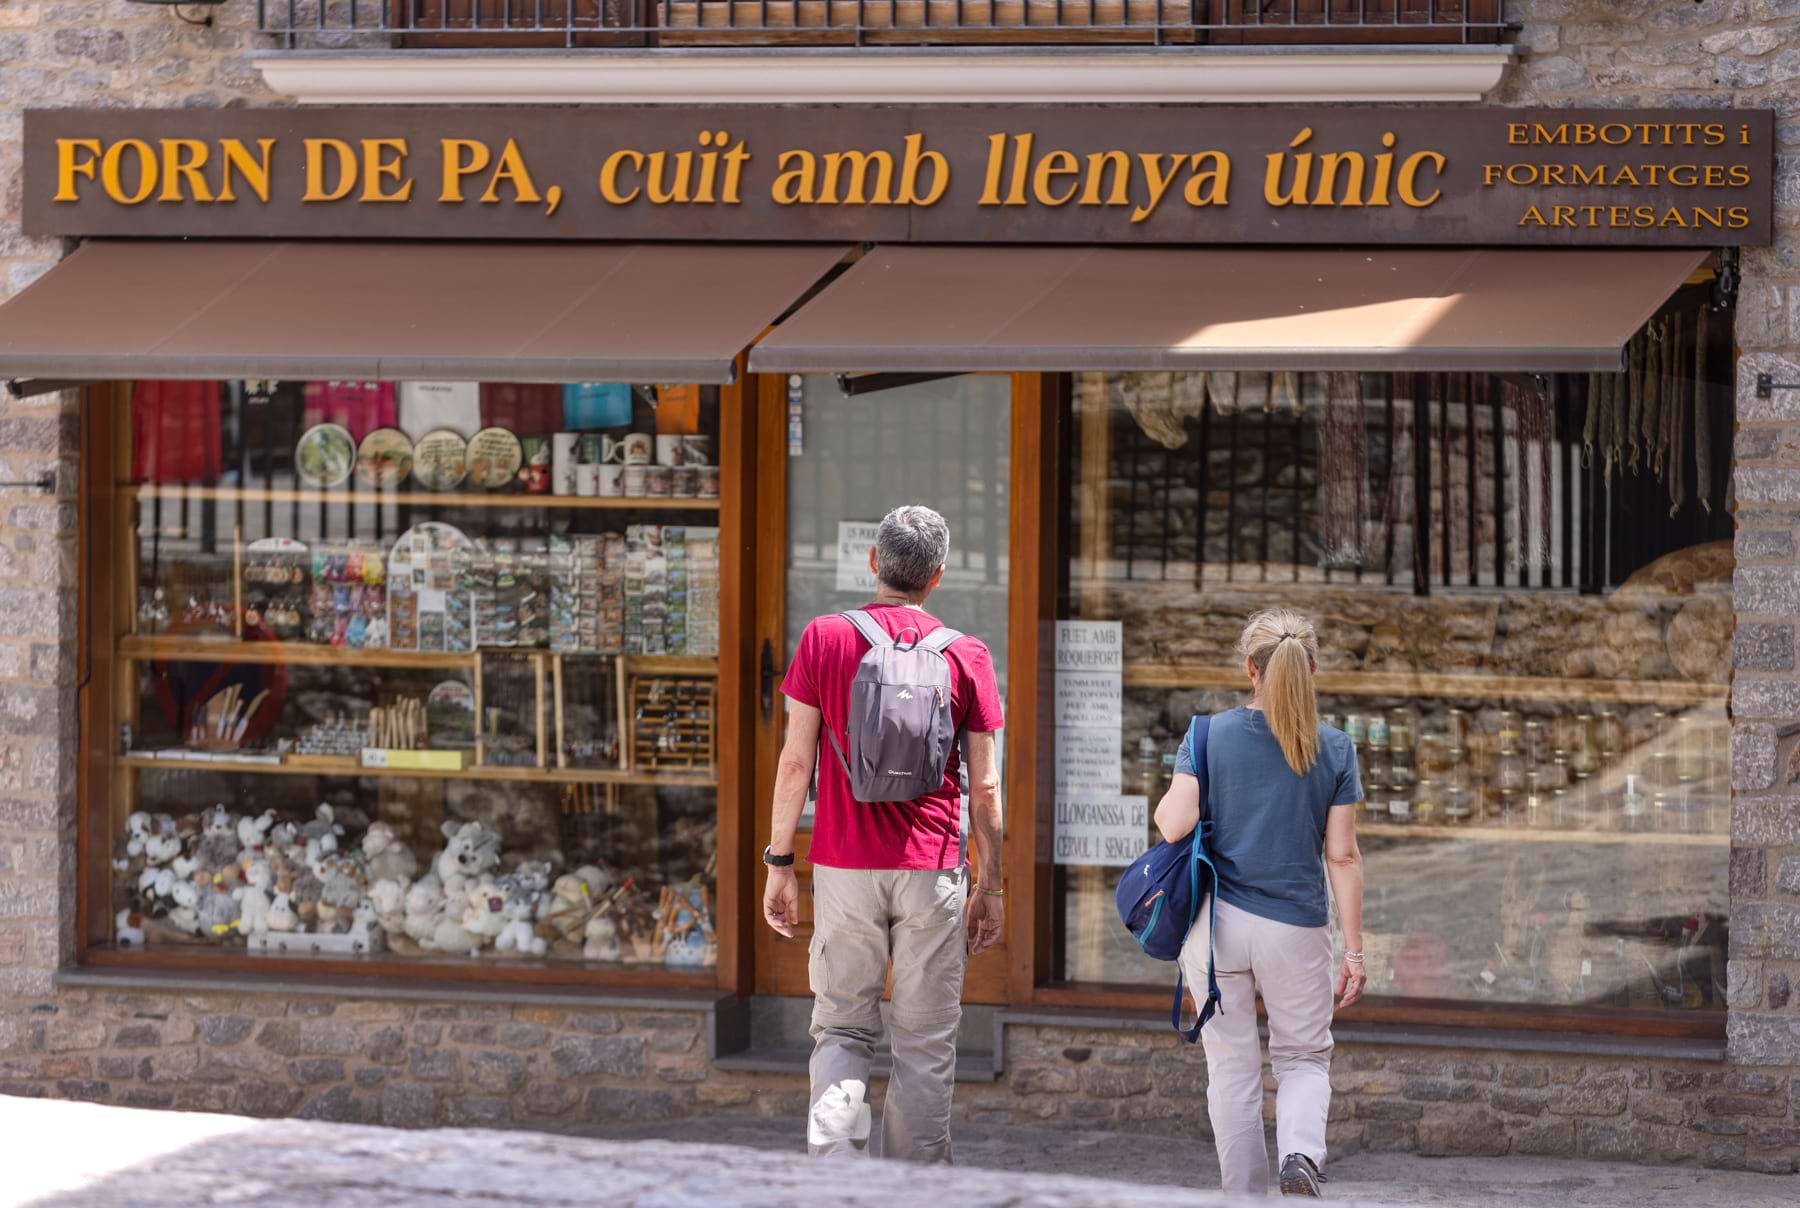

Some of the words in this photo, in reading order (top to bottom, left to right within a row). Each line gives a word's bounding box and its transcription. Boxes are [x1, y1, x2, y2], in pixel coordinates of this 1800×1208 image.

[1507, 123, 1726, 145] EMBOTITS
[1739, 124, 1751, 145] i
[54, 137, 275, 204] FORN
[303, 137, 413, 202] DE
[438, 137, 562, 216] PA,
[599, 129, 751, 204] cuït
[771, 132, 949, 206] amb
[979, 132, 1230, 223] llenya
[1263, 127, 1446, 207] únic
[1482, 163, 1751, 187] FORMATGES
[1517, 205, 1750, 228] ARTESANS
[1061, 627, 1087, 644] FUET
[1093, 629, 1117, 645] AMB
[1057, 649, 1120, 667] ROQUEFORT
[1057, 803, 1126, 826] LLONGANISSA
[1132, 805, 1145, 826] DE
[1105, 837, 1145, 859] SENGLAR
